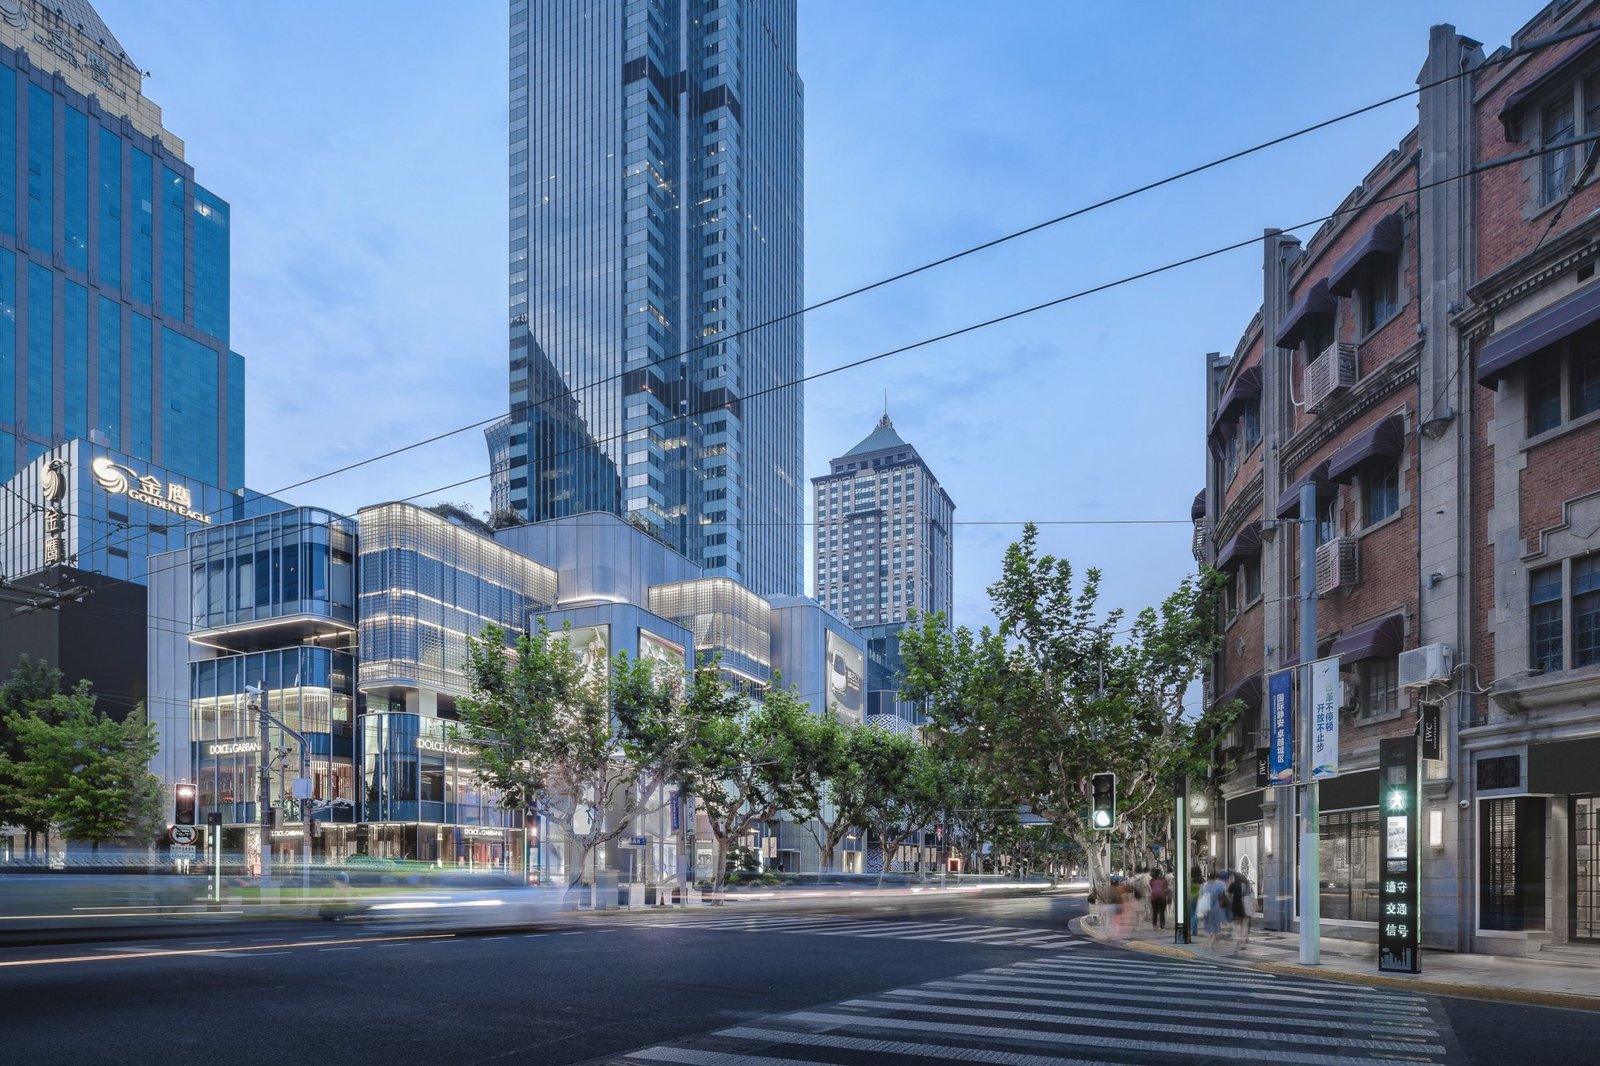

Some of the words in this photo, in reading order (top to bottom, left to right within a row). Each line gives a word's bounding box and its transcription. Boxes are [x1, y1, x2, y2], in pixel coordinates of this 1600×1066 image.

[138, 475, 192, 509] 金鹰
[128, 489, 177, 513] GOLDEN
[178, 505, 212, 525] EAGLE
[44, 506, 60, 564] 金鹰
[1316, 703, 1325, 753] 开放不止步
[1425, 722, 1433, 742] IWC
[210, 742, 262, 755] DOLCE&GABBAN
[1385, 881, 1408, 894] 遵守
[1386, 902, 1408, 915] 交通
[1386, 923, 1409, 937] 信号
